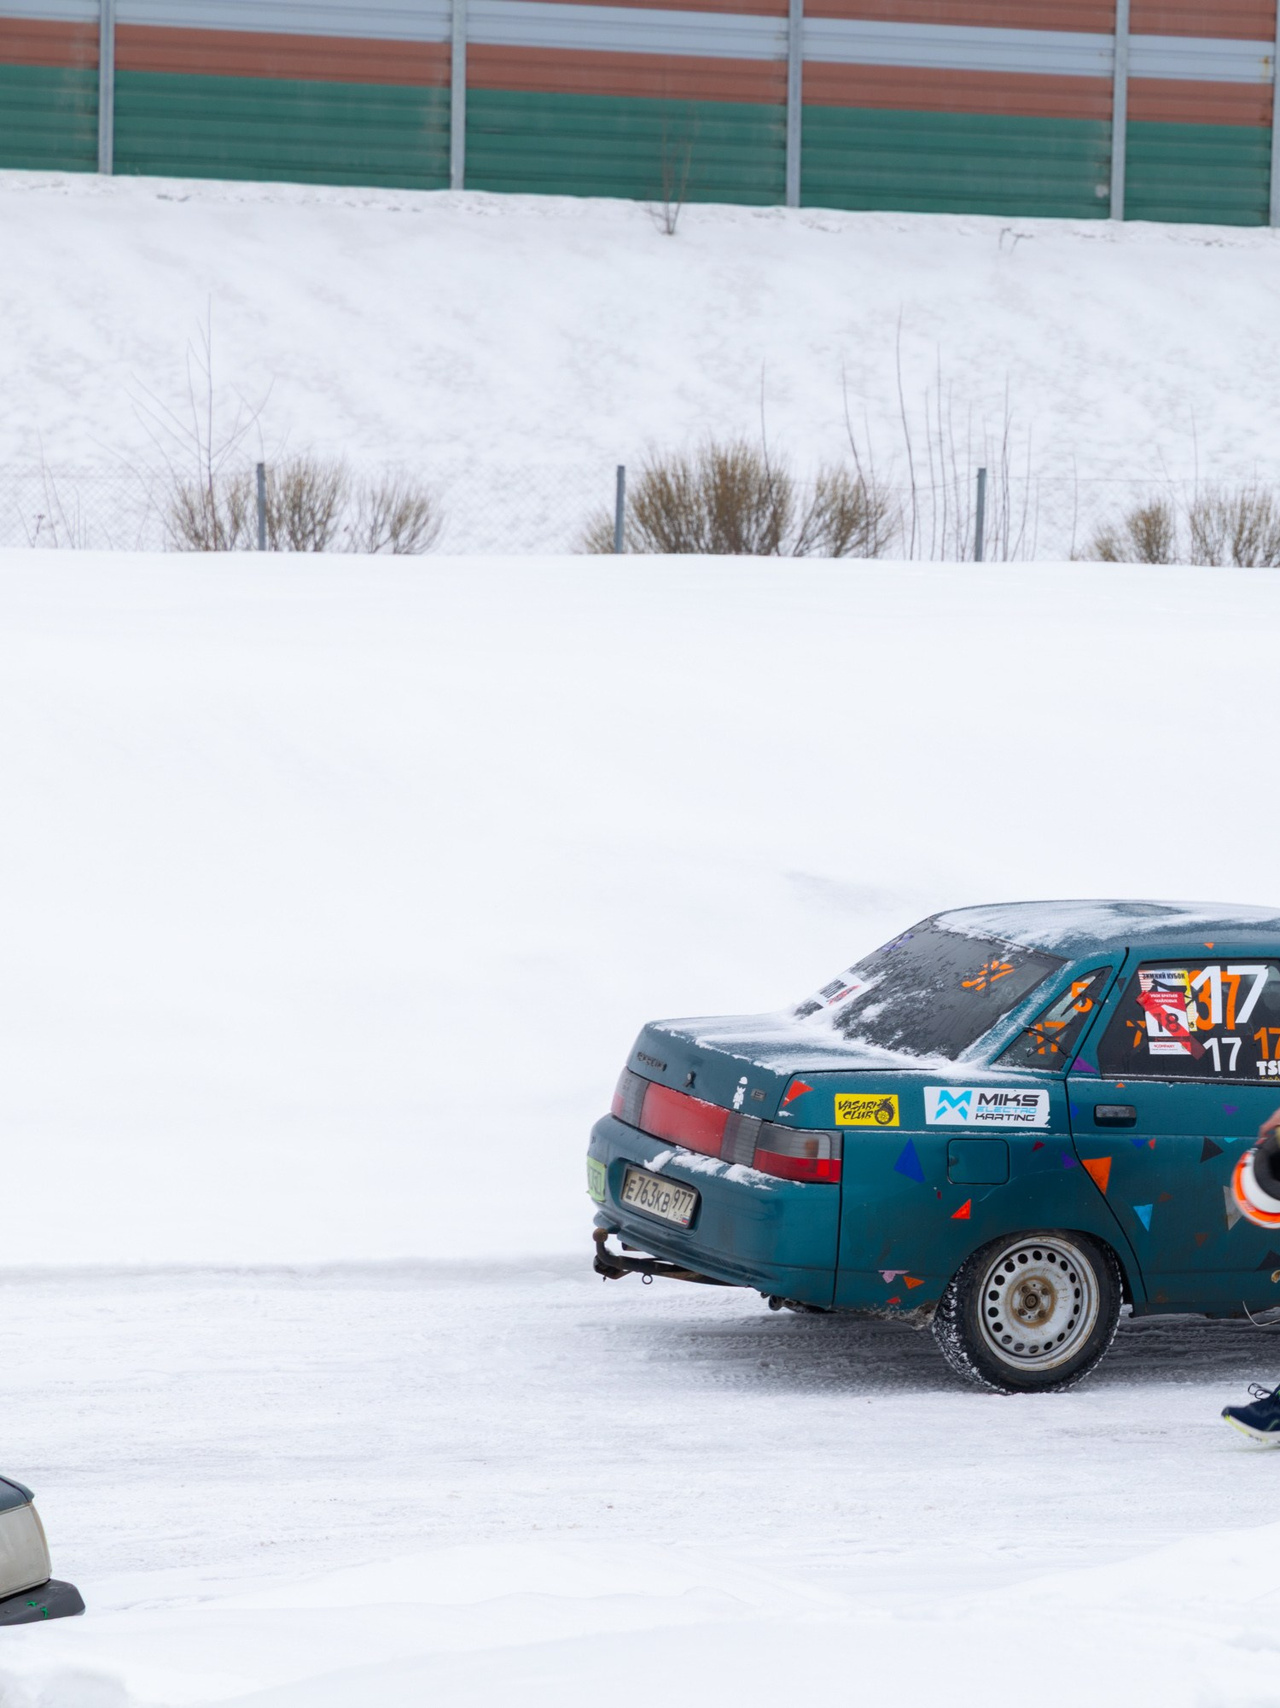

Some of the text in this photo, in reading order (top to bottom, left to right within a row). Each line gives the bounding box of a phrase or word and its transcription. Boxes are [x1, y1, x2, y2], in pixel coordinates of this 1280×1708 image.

[1190, 965, 1269, 1024] 17
[1152, 1013, 1179, 1033] 18
[1202, 1037, 1242, 1072] 17
[838, 1099, 877, 1111] VASARI
[978, 1093, 1040, 1107] MIKS
[843, 1110, 873, 1120] CLUB
[976, 1106, 1037, 1114] ELECTRO
[975, 1113, 1036, 1122] KARTING
[671, 1189, 694, 1214] 977
